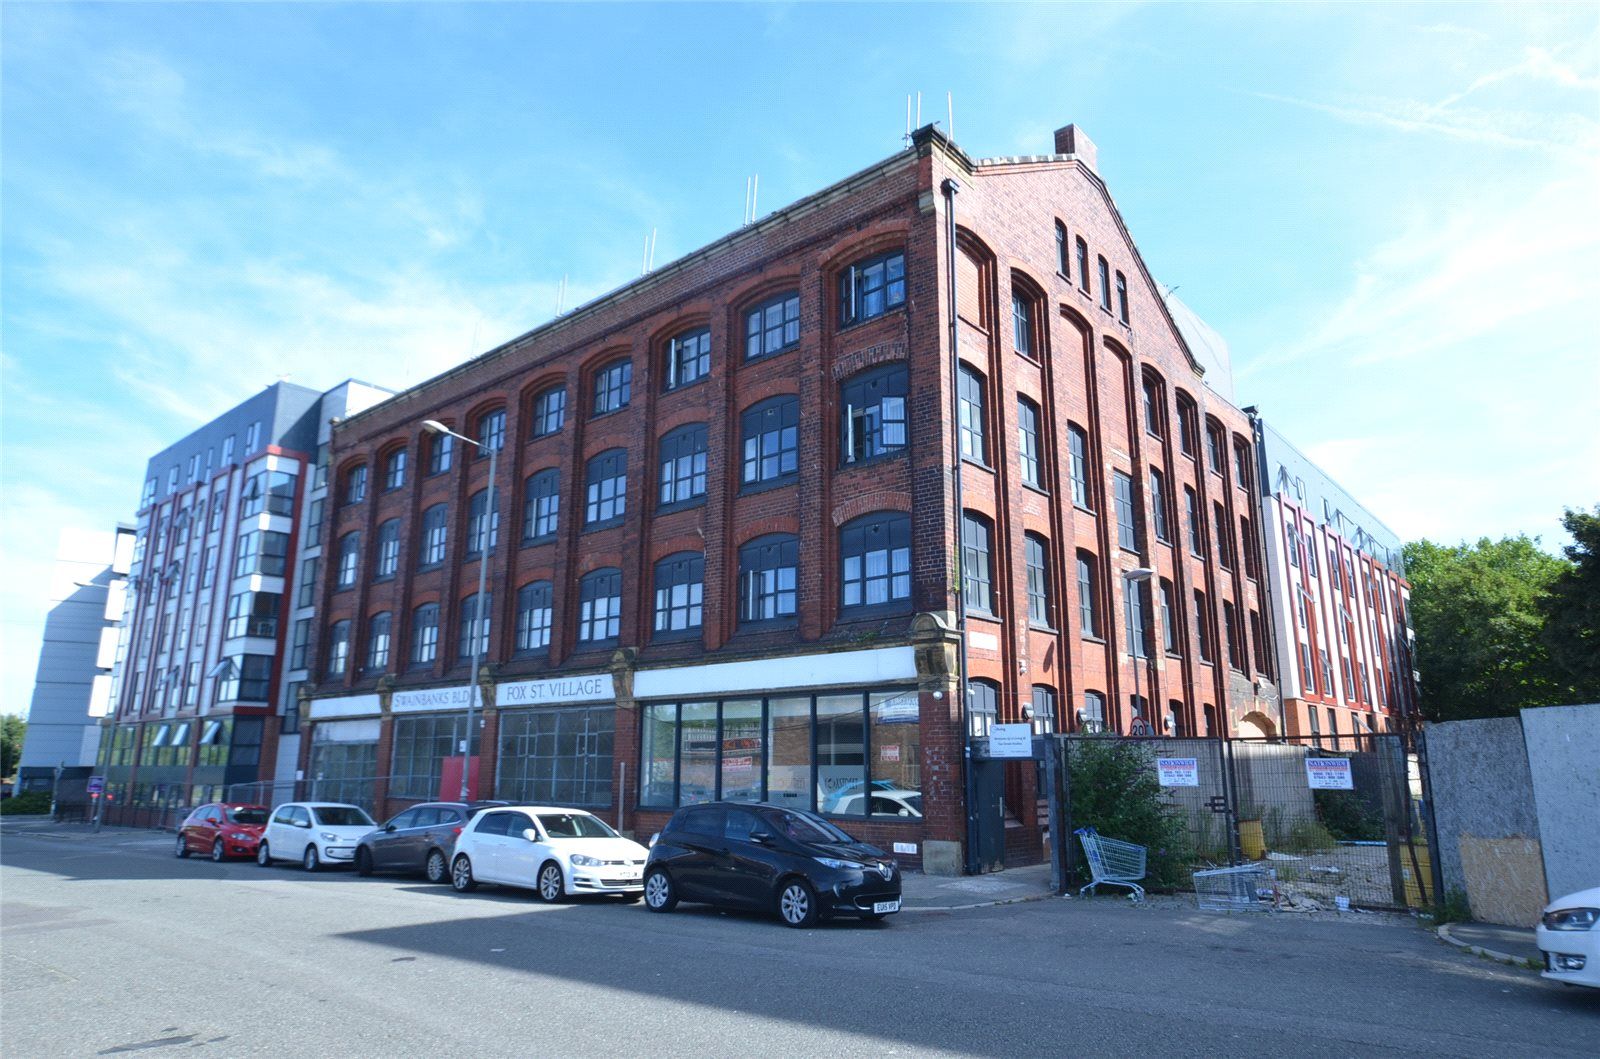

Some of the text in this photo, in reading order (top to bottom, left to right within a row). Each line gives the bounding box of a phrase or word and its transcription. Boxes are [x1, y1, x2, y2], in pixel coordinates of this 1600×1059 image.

[507, 678, 602, 700] FOX ST. VILLAGE
[1132, 725, 1144, 736] 20
